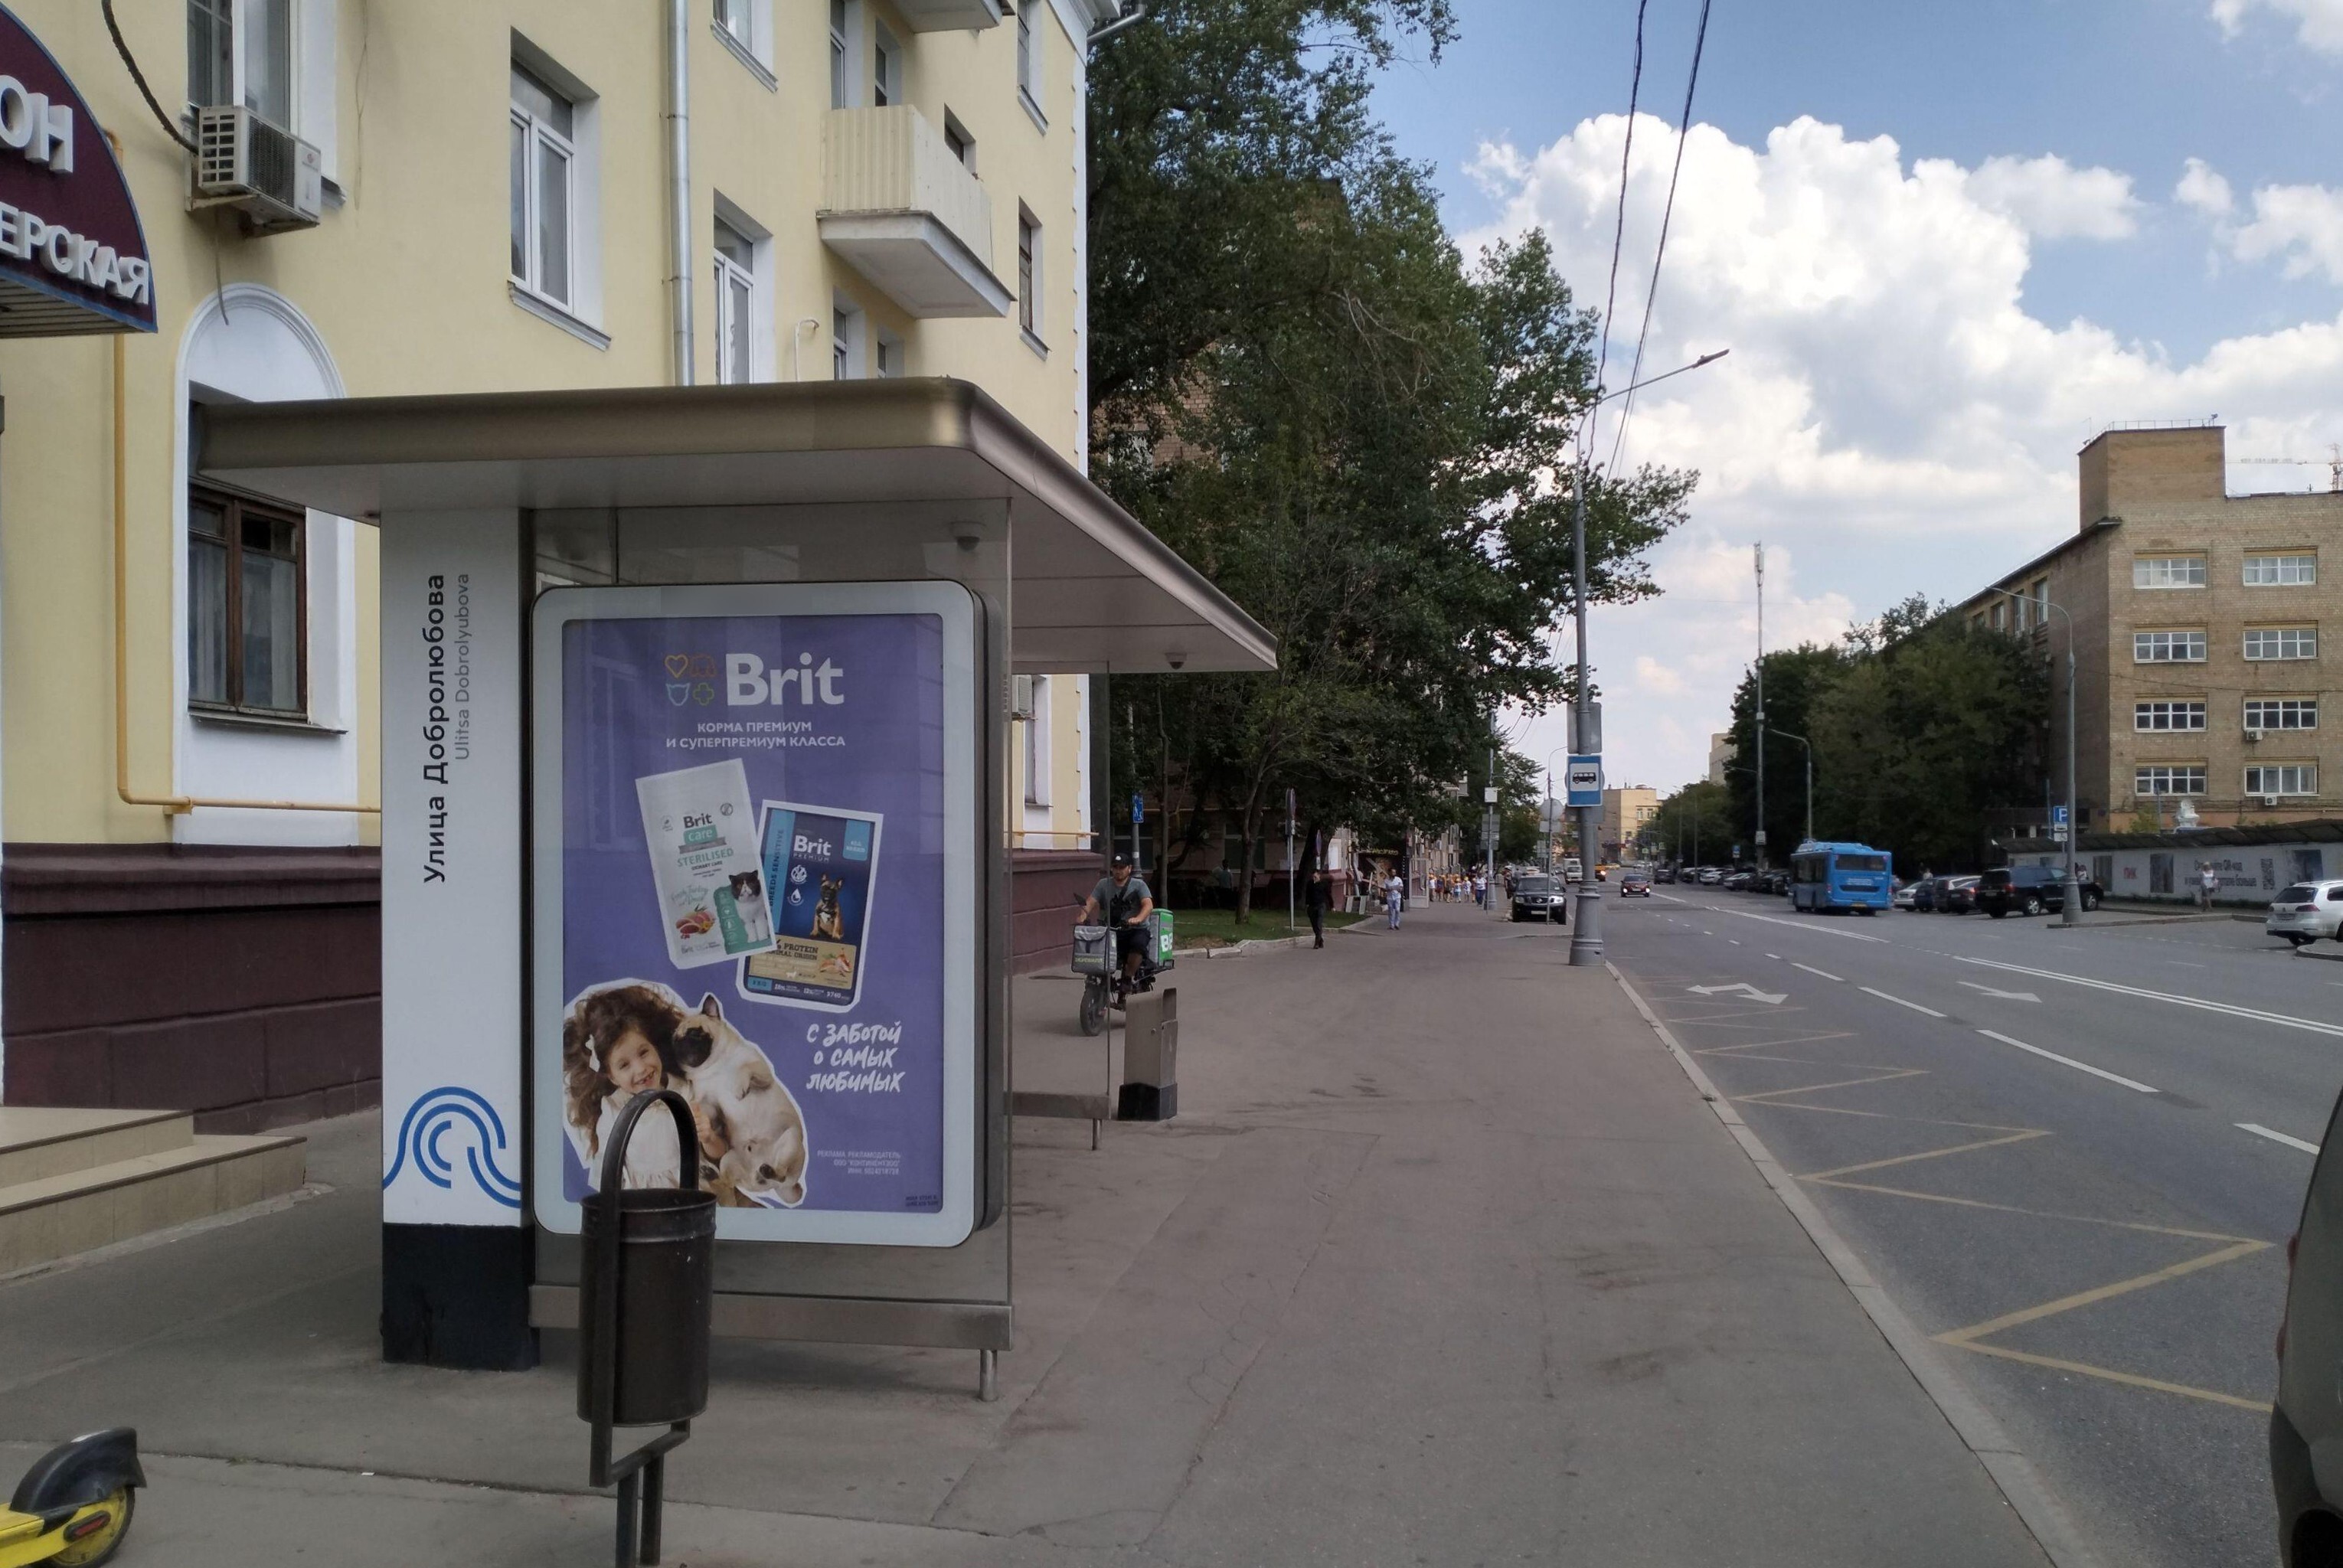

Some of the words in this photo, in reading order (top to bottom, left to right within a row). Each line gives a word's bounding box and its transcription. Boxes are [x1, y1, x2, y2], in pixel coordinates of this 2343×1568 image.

[453, 573, 472, 703] Dobrolyubova
[423, 574, 449, 785] Добролюбова
[725, 652, 845, 706] Brit
[454, 708, 470, 760] Ulitsa
[698, 722, 743, 733] КОРМА
[746, 721, 812, 733] ПРЕМИУМ
[665, 737, 676, 748] И
[679, 736, 786, 750] СУПЕРПРЕМИУМ
[789, 735, 846, 747] КЛАССА
[683, 812, 713, 829] Brit
[423, 795, 448, 884] Улица
[688, 828, 714, 841] care
[773, 829, 785, 872] SENSITIVE
[793, 835, 832, 856] Brit
[677, 848, 734, 867] STERILISED
[792, 852, 831, 863] PREMIUM
[783, 942, 819, 954] PROTEIN
[830, 1046, 898, 1069] САМЫХ
